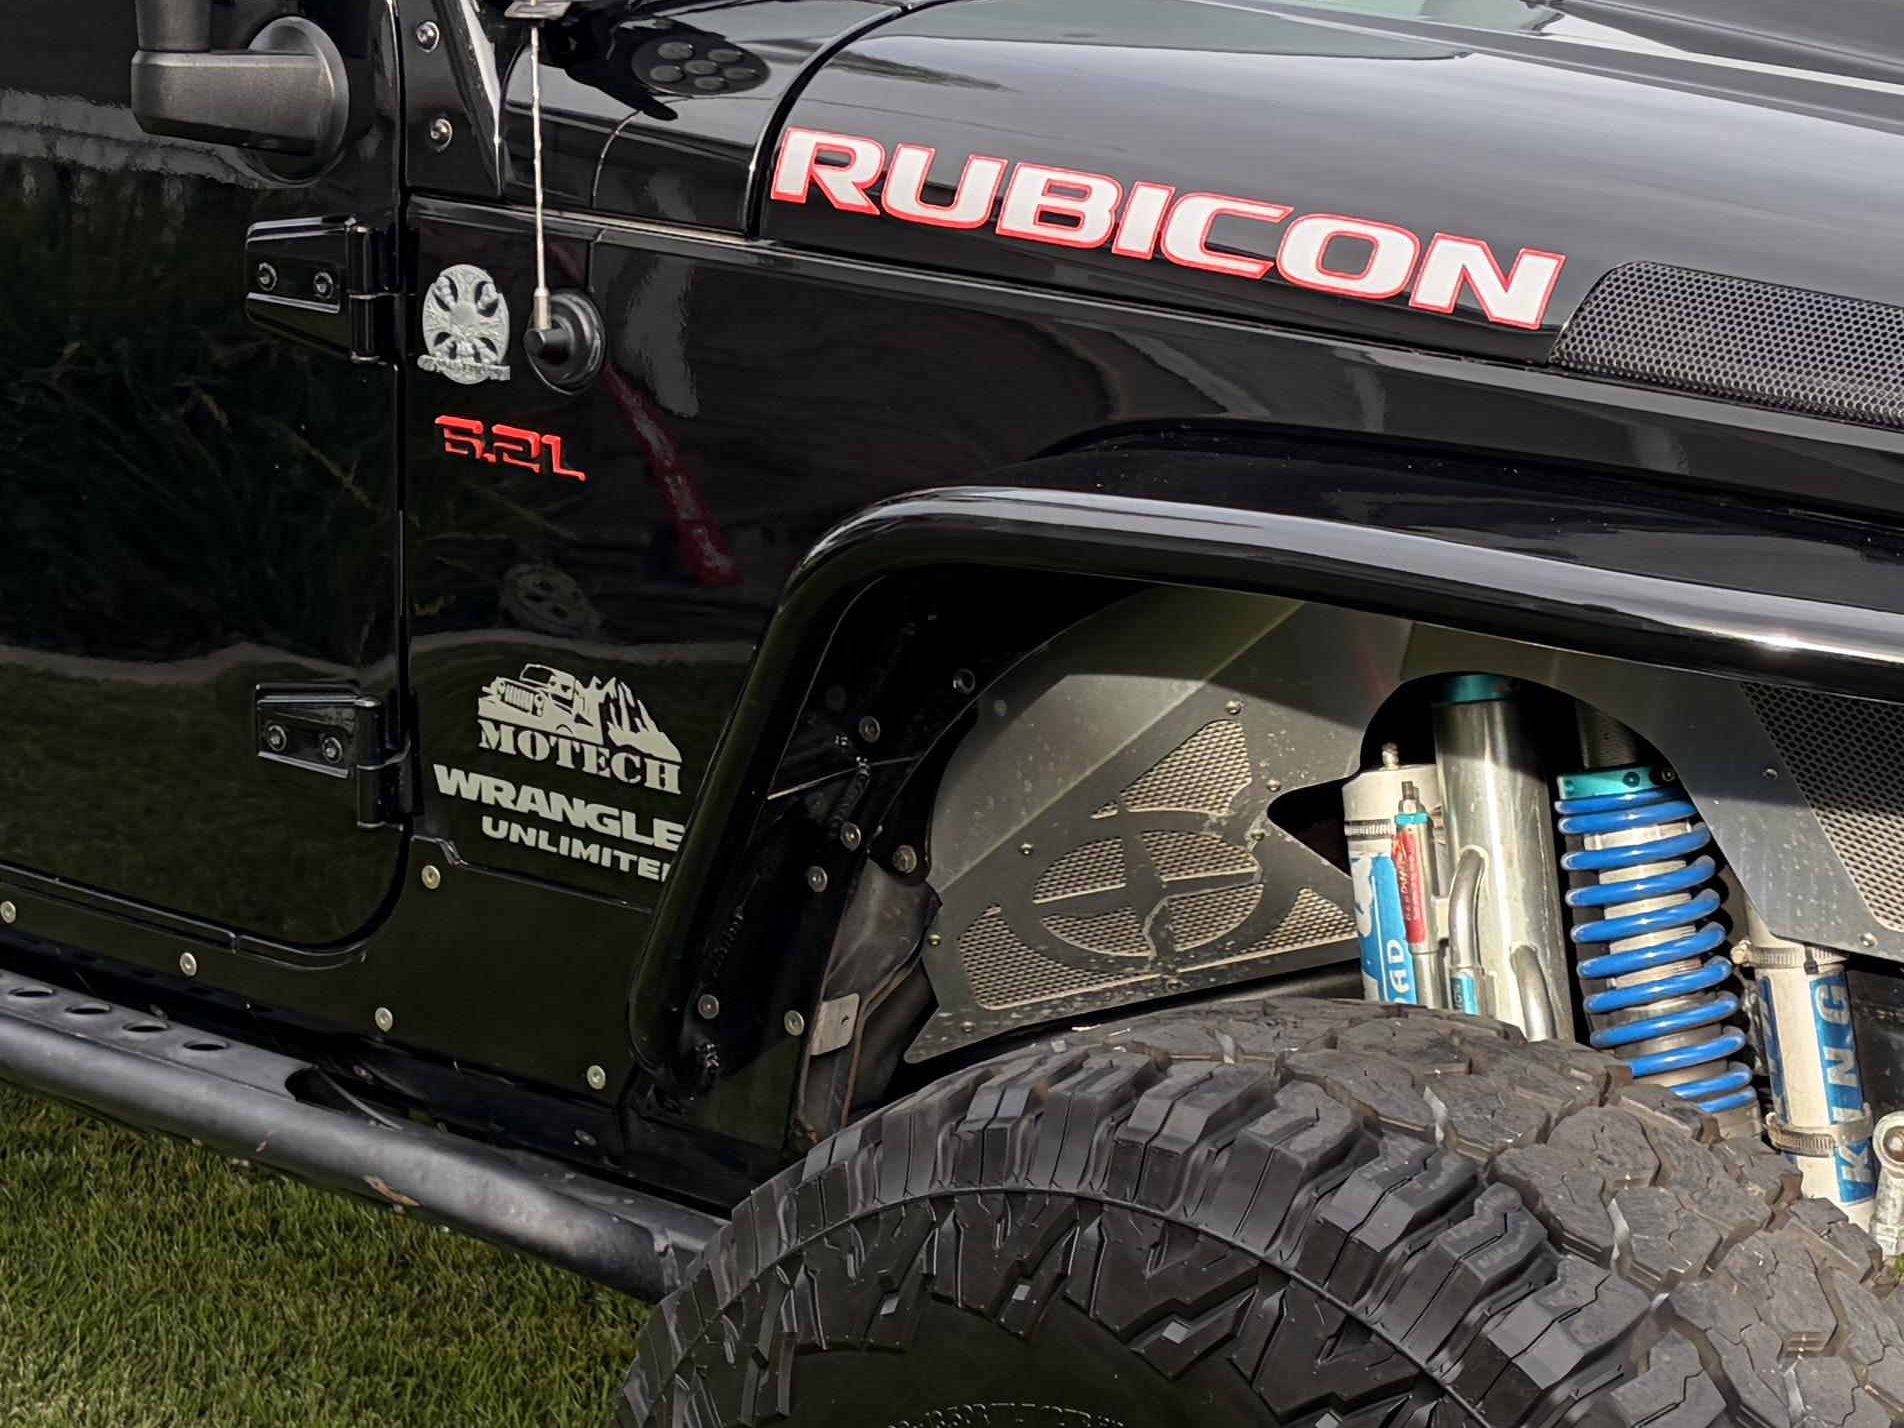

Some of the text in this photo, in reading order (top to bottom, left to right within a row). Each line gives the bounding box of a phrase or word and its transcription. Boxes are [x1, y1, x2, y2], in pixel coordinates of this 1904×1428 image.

[770, 126, 1567, 330] RUBICON
[433, 763, 686, 852] WRANGLE
[477, 719, 682, 795] MOTECH
[1814, 983, 1874, 1184] KING
